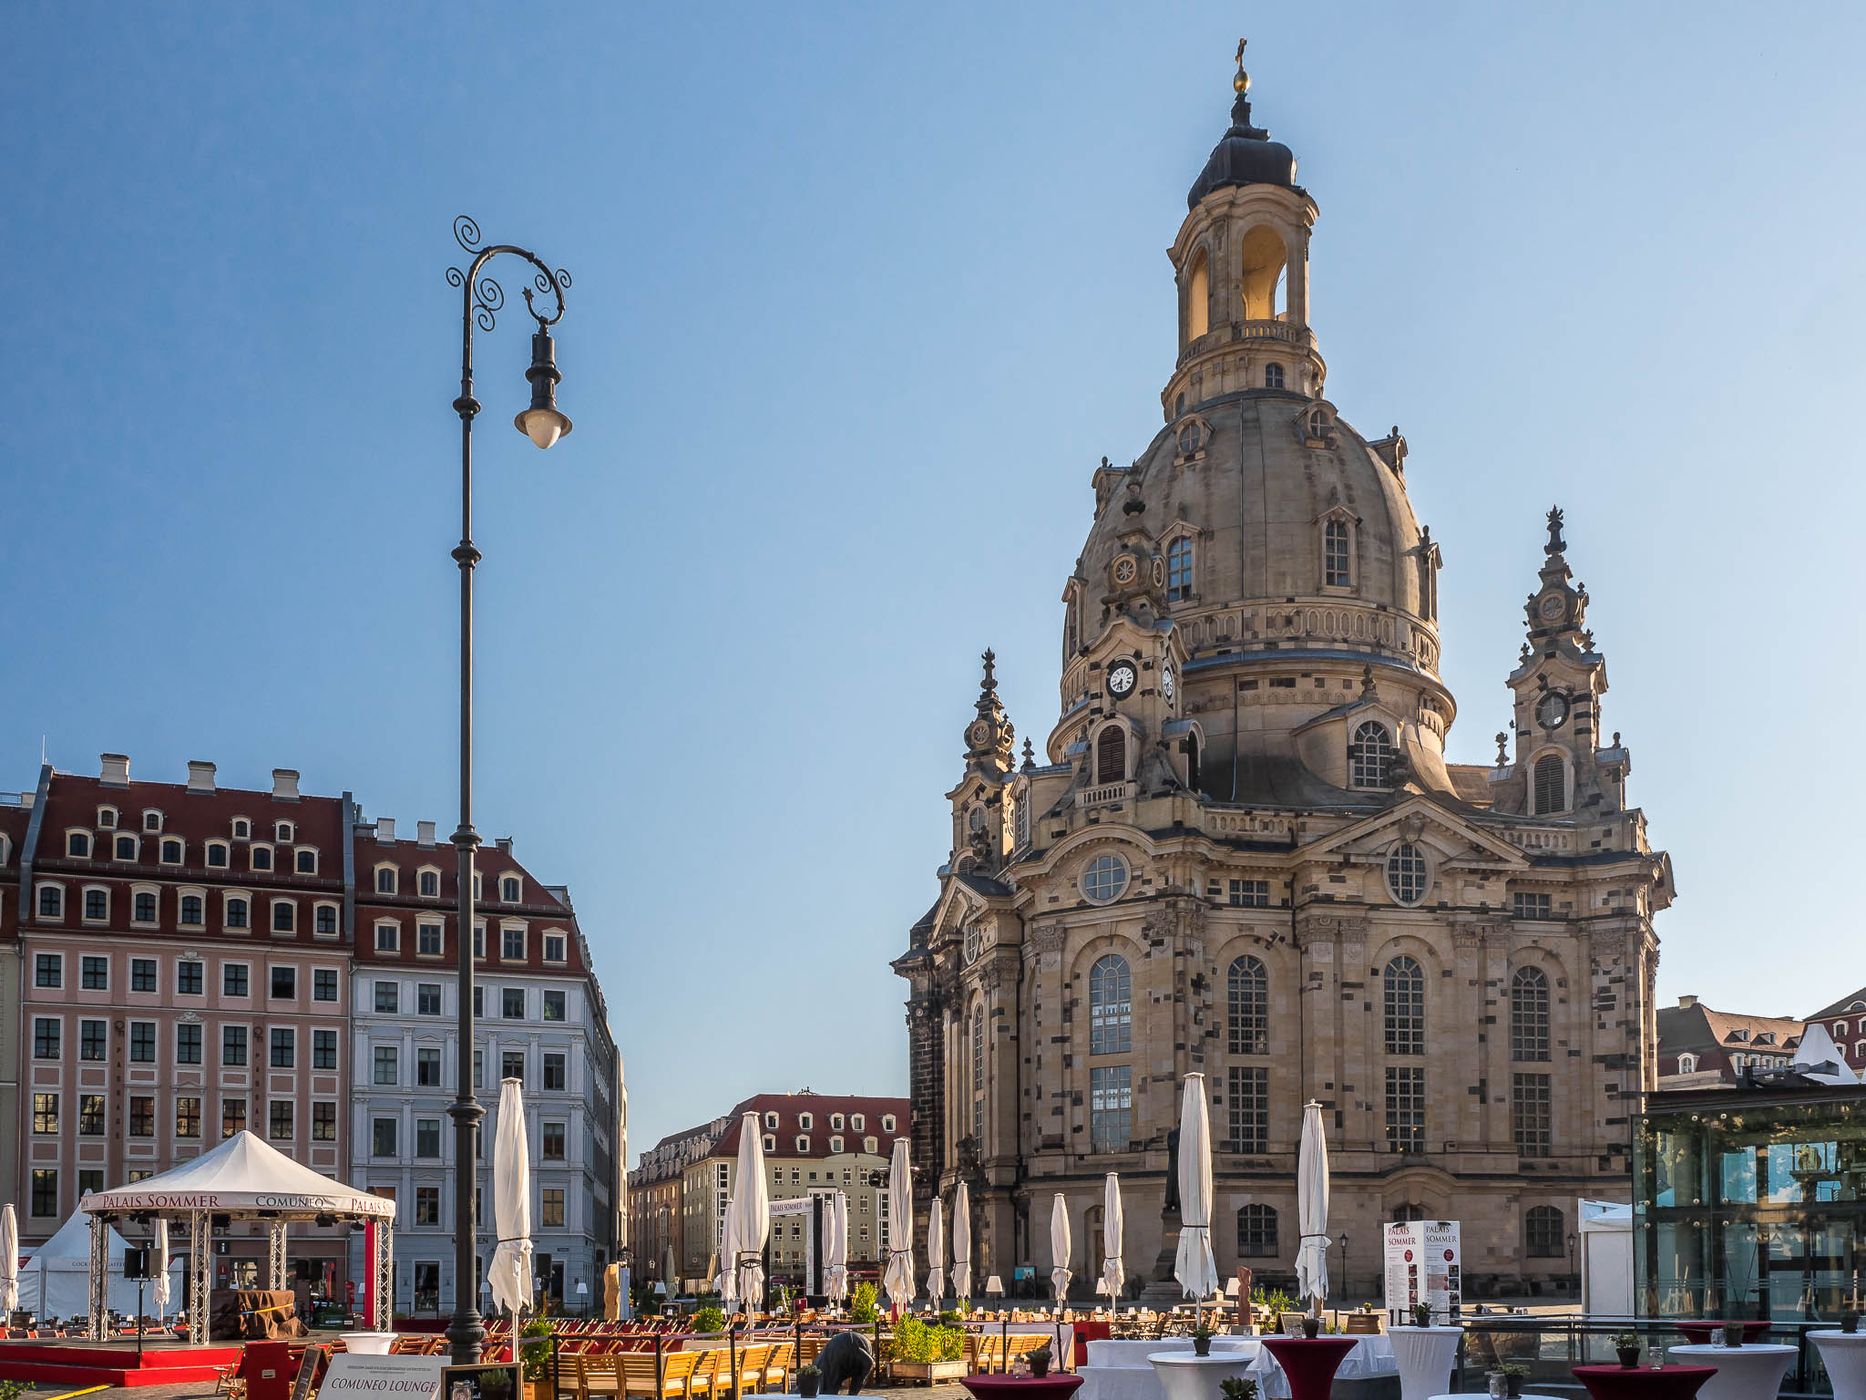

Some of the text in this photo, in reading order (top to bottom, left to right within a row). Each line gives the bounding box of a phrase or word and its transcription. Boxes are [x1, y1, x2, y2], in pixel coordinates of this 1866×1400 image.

[103, 1195, 142, 1209] PALAIS
[147, 1194, 220, 1208] SOMMER
[255, 1195, 324, 1208] COMUNEO
[351, 1198, 382, 1213] PALAIS
[1388, 1227, 1410, 1236] PALAIS
[1426, 1225, 1450, 1234] PALAIS
[1388, 1237, 1417, 1246] SOMMER
[1426, 1234, 1457, 1243] SOMMER
[331, 1377, 437, 1393] COMUNEO LOUNGE
